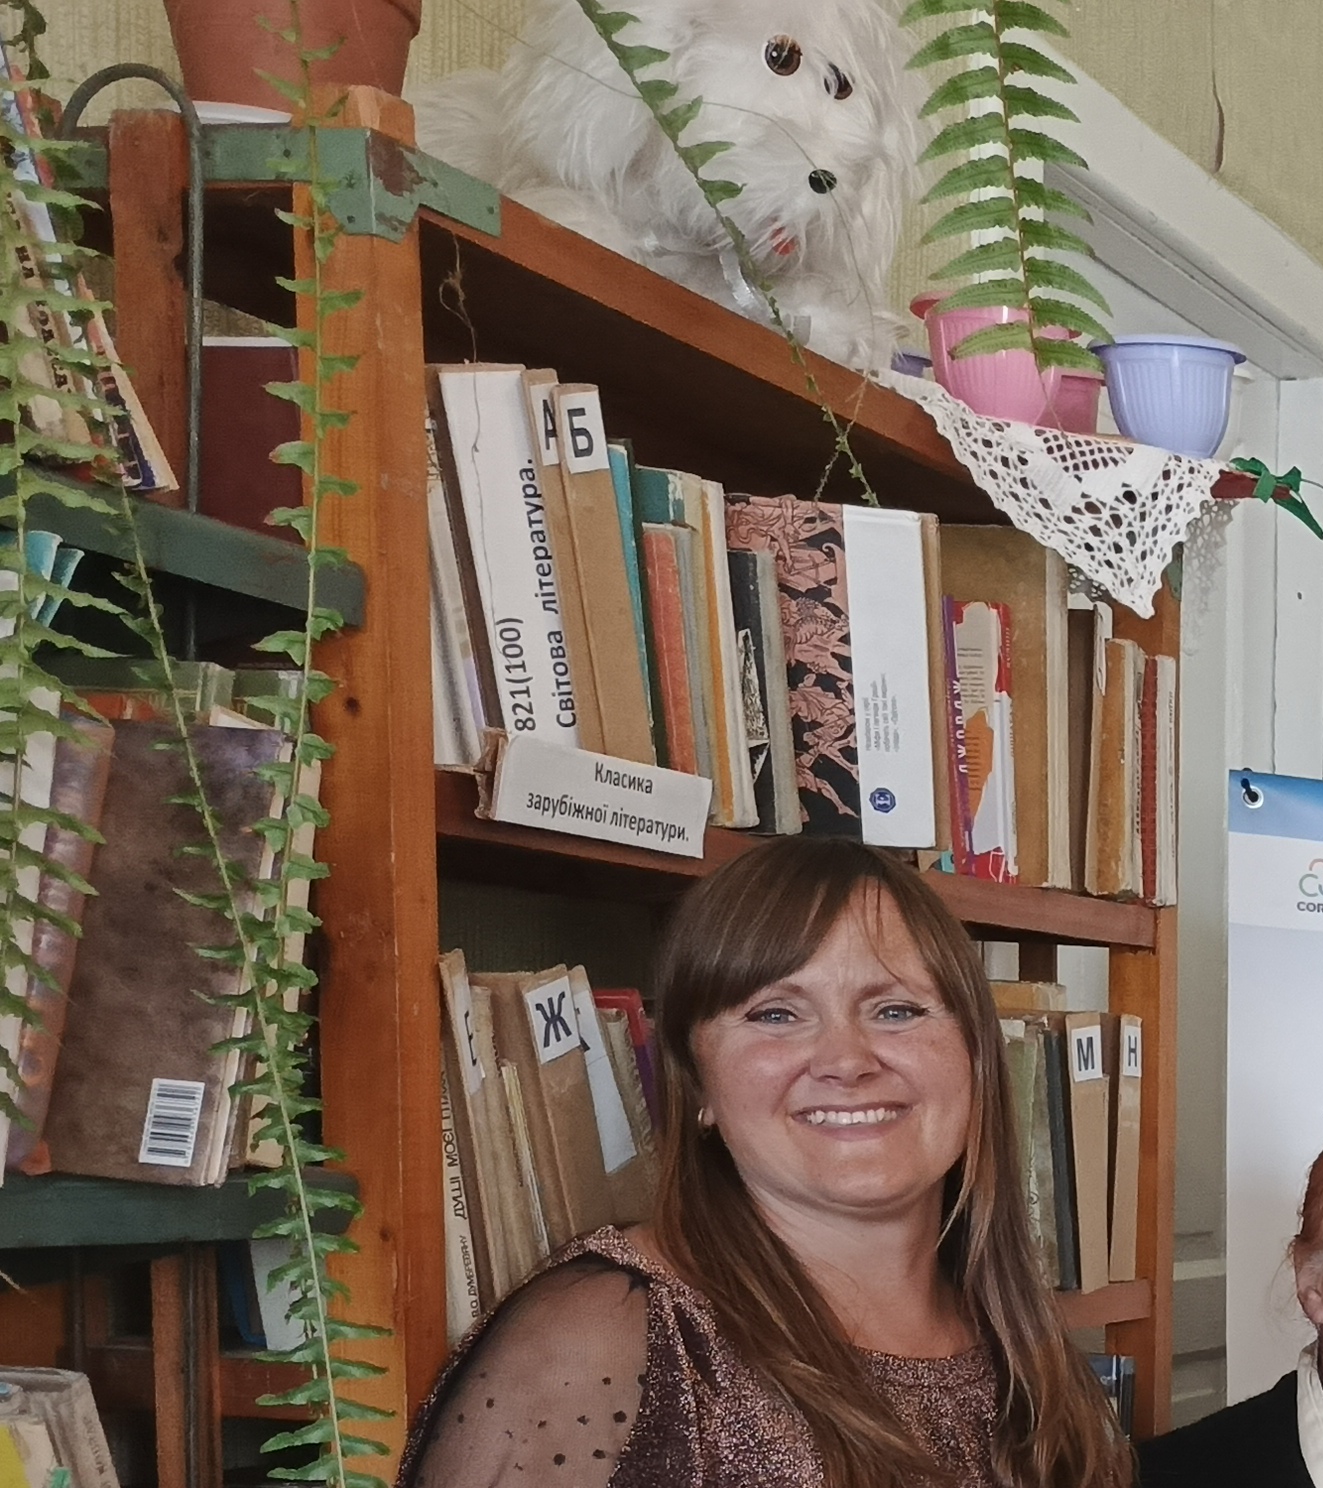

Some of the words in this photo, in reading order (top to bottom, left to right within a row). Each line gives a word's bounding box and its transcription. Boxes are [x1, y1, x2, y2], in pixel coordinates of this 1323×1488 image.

[567, 407, 594, 458] Б
[519, 458, 557, 616] література.
[497, 617, 537, 731] 821(100)
[546, 629, 579, 728] Світова
[594, 761, 654, 795] Класика
[526, 791, 608, 824] зарубіжної
[609, 806, 690, 843] літератури.
[535, 991, 573, 1048] Ж
[1076, 1036, 1095, 1072] М
[1128, 1035, 1138, 1067] Н
[449, 1175, 468, 1220] ДУШІ
